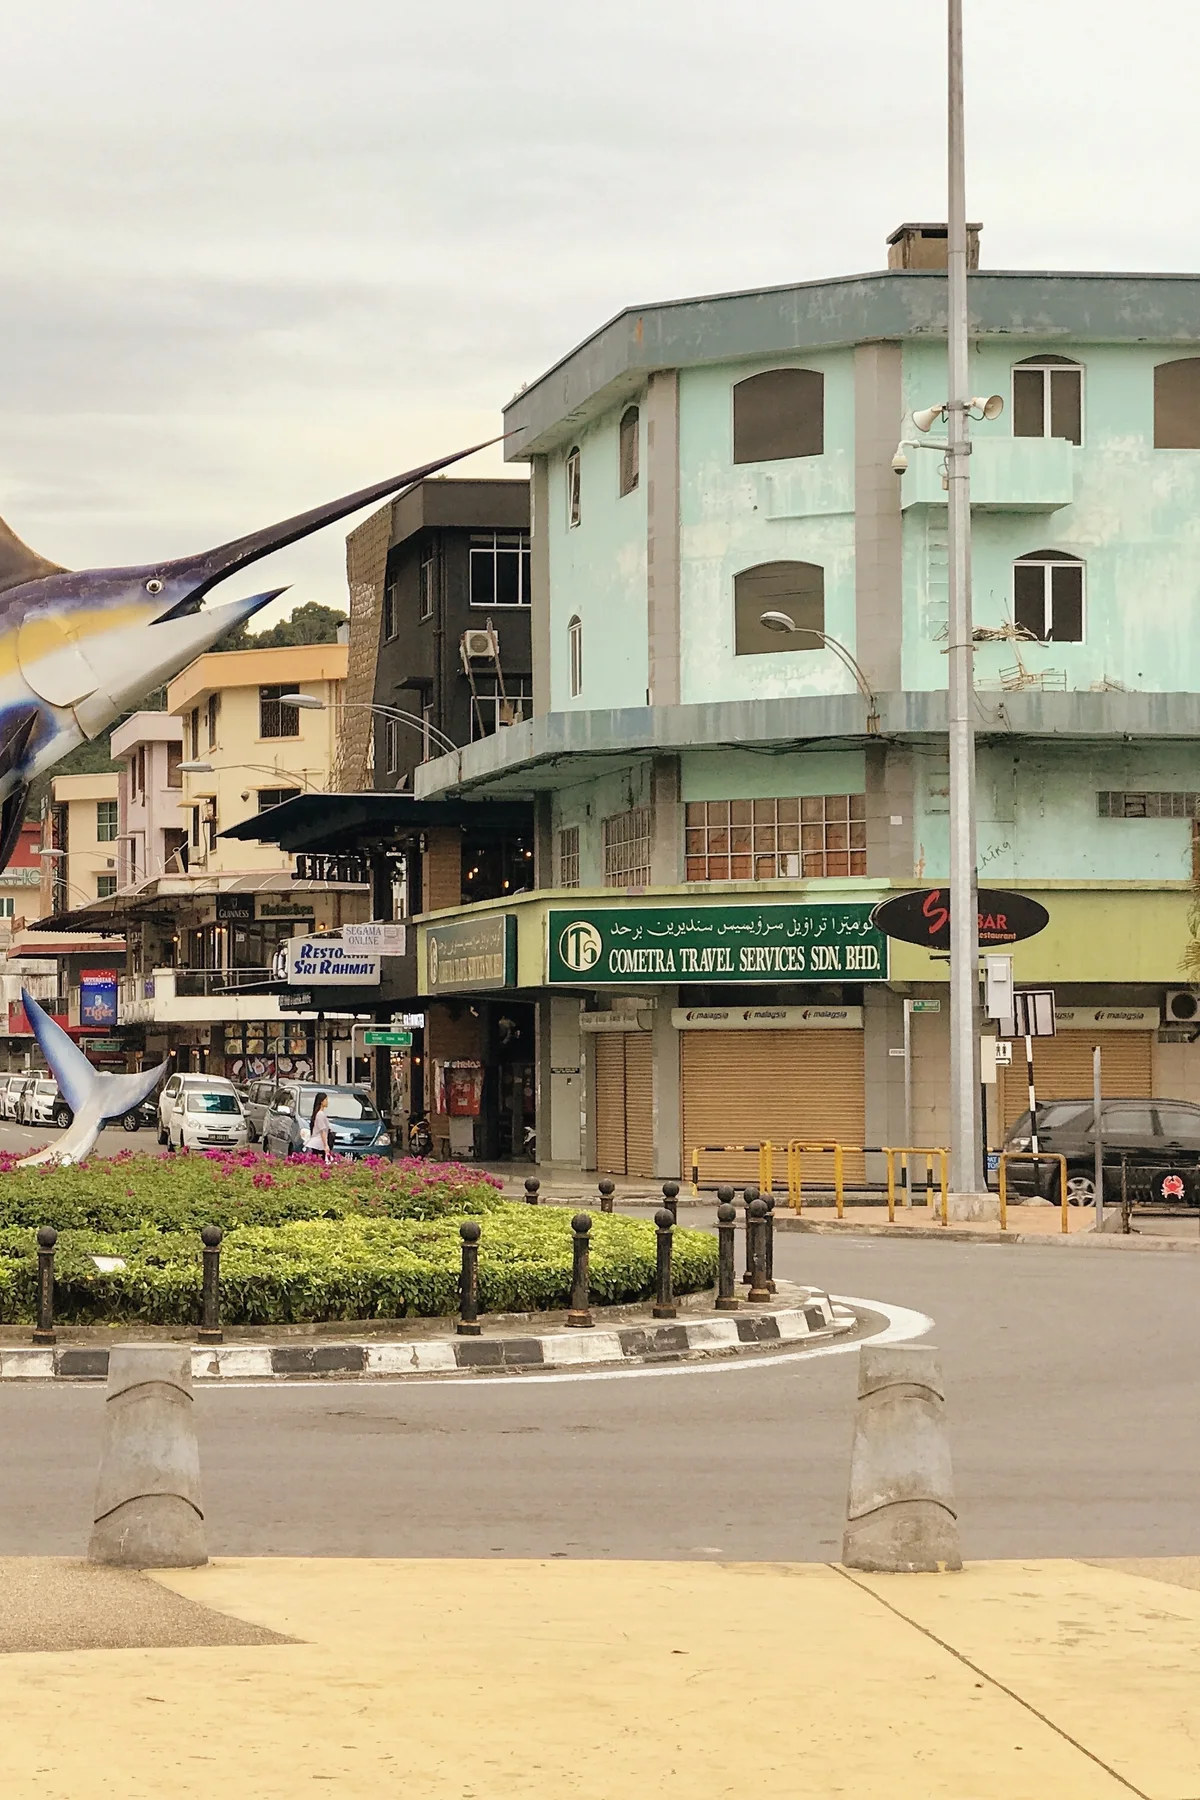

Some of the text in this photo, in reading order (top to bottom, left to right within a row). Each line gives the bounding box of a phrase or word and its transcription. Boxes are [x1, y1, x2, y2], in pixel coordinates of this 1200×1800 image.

[218, 908, 249, 919] GUINNESS
[345, 926, 382, 936] SEGAMA
[978, 932, 1016, 940] estaurant
[348, 936, 380, 946] ONLINE
[300, 943, 369, 959] RESTO
[608, 945, 881, 974] COMETRA TRAVEL SERVICES SDN. BHD.
[294, 959, 376, 975] SRI RAHMAT
[84, 1006, 115, 1021] Tiger
